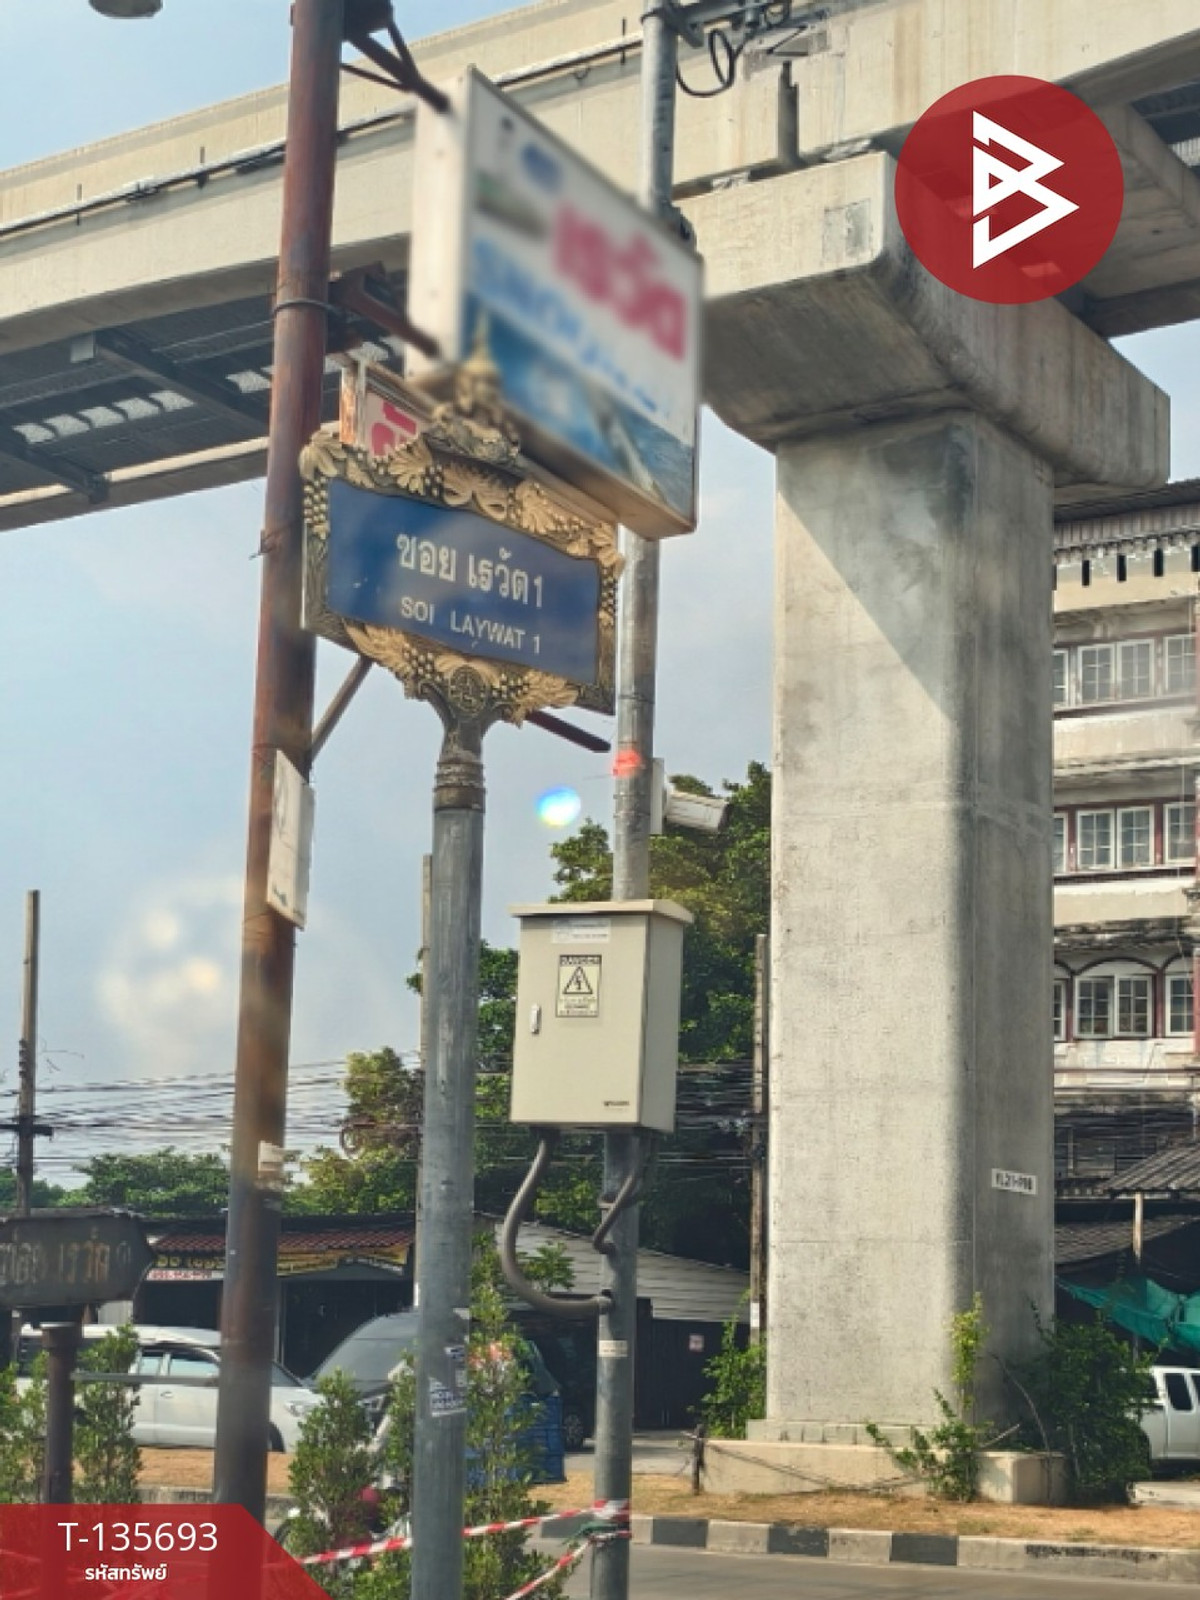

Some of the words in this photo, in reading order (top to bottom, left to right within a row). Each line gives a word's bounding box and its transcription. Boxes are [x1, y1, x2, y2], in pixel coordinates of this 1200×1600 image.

[396, 533, 457, 582] ซอย
[401, 596, 435, 625] SOI
[450, 610, 526, 650] LAYWAT
[533, 633, 541, 655] 1
